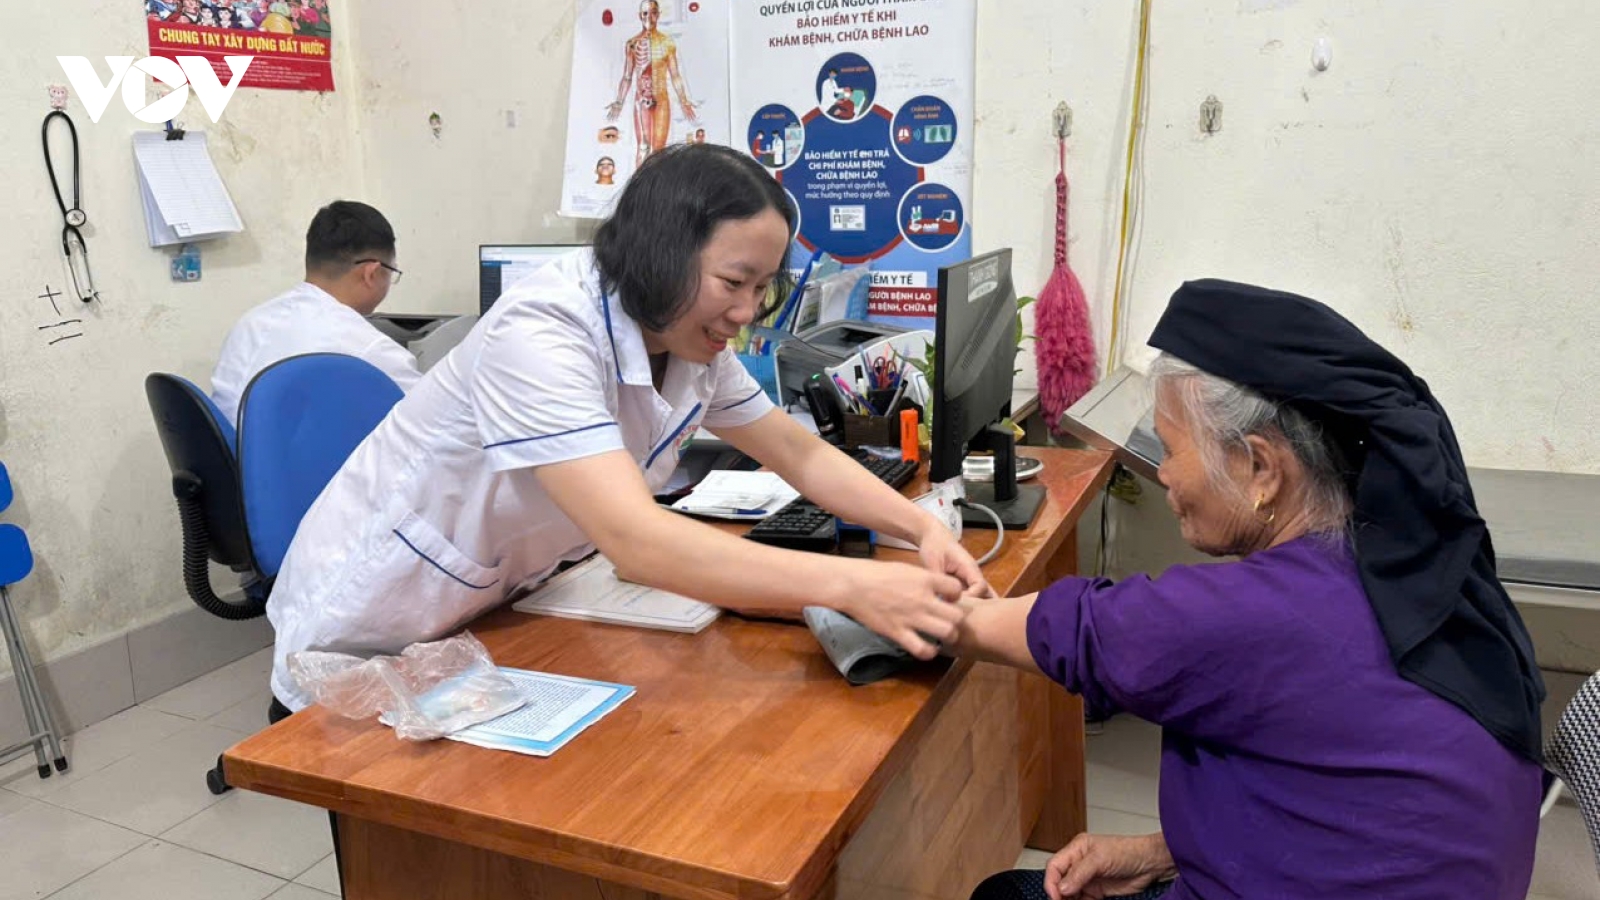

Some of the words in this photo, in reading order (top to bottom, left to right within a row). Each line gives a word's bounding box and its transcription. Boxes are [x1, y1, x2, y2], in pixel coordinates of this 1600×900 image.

[797, 15, 819, 29] BẢO
[822, 11, 850, 26] HIỂM
[850, 13, 859, 24] Y
[861, 9, 875, 23] TẾ
[877, 10, 897, 22] KHI
[159, 27, 199, 44] CHUNG
[201, 32, 221, 47] TAY
[223, 32, 244, 49] XÂY
[247, 36, 277, 53] DỰNG
[279, 36, 298, 53] ĐẤT
[300, 39, 326, 56] NƯỚC
[769, 34, 800, 48] KHÁM
[802, 32, 835, 46] BỆNH,
[836, 29, 869, 43] CHỮA
[872, 26, 903, 41] BỆNH
[905, 24, 929, 37] LAO
[804, 150, 821, 160] BẢO
[822, 149, 841, 160] HIỂM
[842, 150, 849, 158] Y
[849, 149, 858, 158] TẾ
[873, 147, 890, 158] TRẢ
[808, 161, 821, 170] CHI
[822, 160, 836, 170] PHÍ
[837, 160, 860, 169] KHÁM
[815, 170, 838, 180] CHỮA
[839, 170, 860, 181] BỆNH
[861, 170, 878, 179] LAO
[843, 191, 859, 199] theo
[859, 192, 873, 200] quy
[873, 190, 891, 199] định
[869, 272, 889, 285] IỂM
[890, 274, 898, 284] Y
[900, 272, 914, 285] TẾ
[868, 290, 889, 300] GƯỜI
[890, 291, 914, 302] BỆNH
[914, 291, 932, 301] LAO
[902, 302, 927, 313] CHỮA
